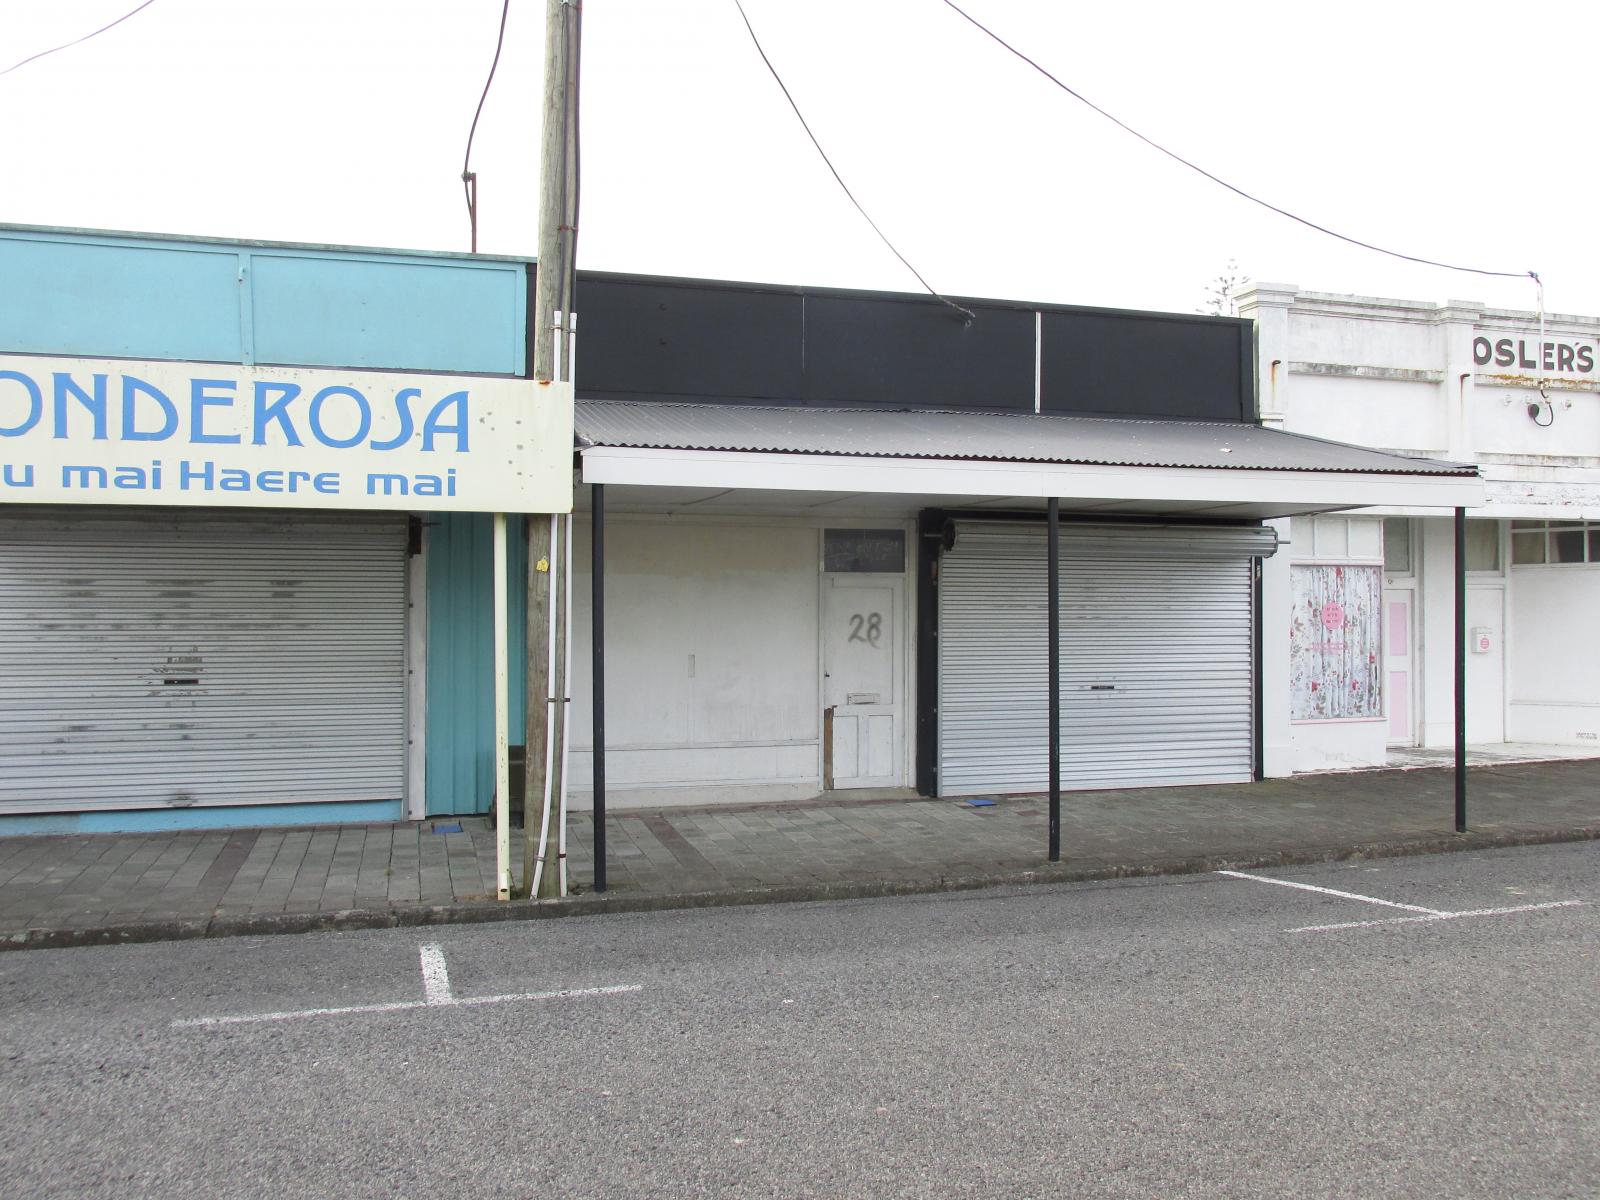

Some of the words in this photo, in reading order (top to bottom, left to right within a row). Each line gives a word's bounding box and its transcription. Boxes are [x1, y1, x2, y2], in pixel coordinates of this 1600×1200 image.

[1473, 336, 1594, 374] OSLER'S
[0, 369, 470, 454] ONDEROSA
[62, 459, 161, 490] mai
[179, 459, 340, 495] Haere
[366, 468, 457, 497] mai
[848, 612, 883, 649] 28
